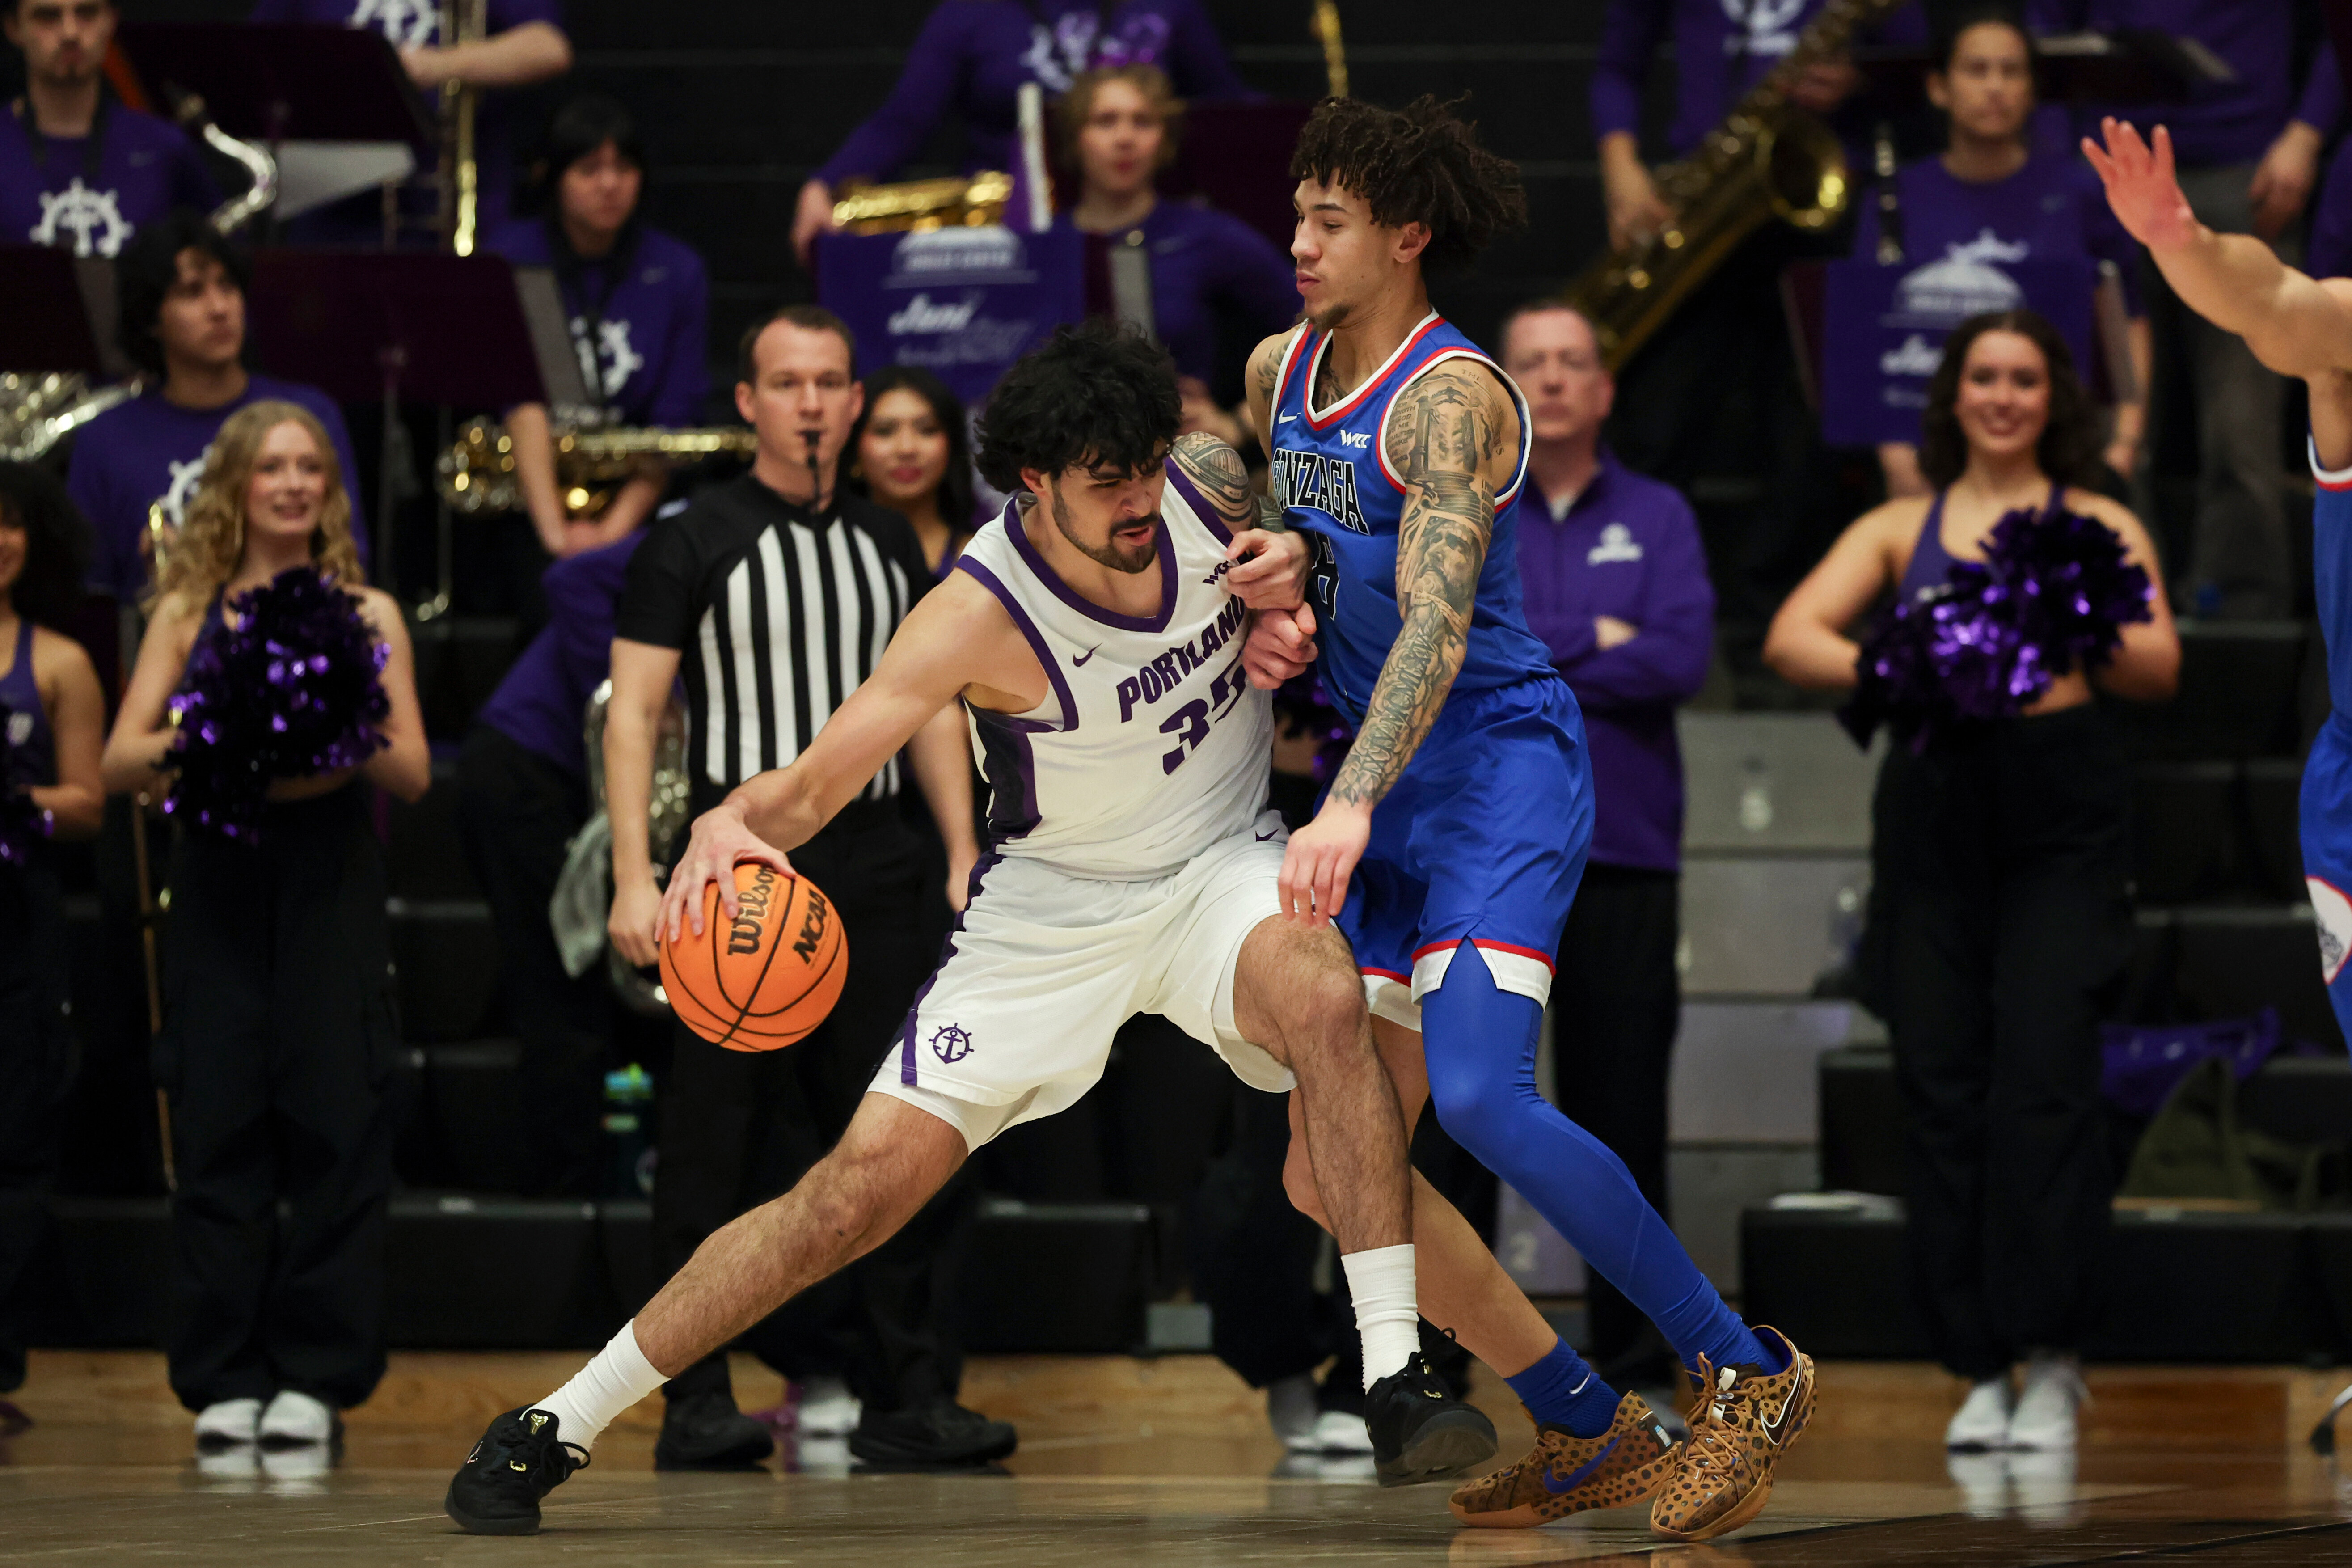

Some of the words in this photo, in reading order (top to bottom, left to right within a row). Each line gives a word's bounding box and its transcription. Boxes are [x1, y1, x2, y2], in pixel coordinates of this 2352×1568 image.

[1340, 429, 1372, 449] WCC
[1272, 448, 1371, 536] GONZAGA
[1116, 593, 1245, 724] PORTLAND
[1159, 649, 1247, 776] 35
[727, 865, 778, 956] Wilson
[792, 888, 827, 965] NCAA
